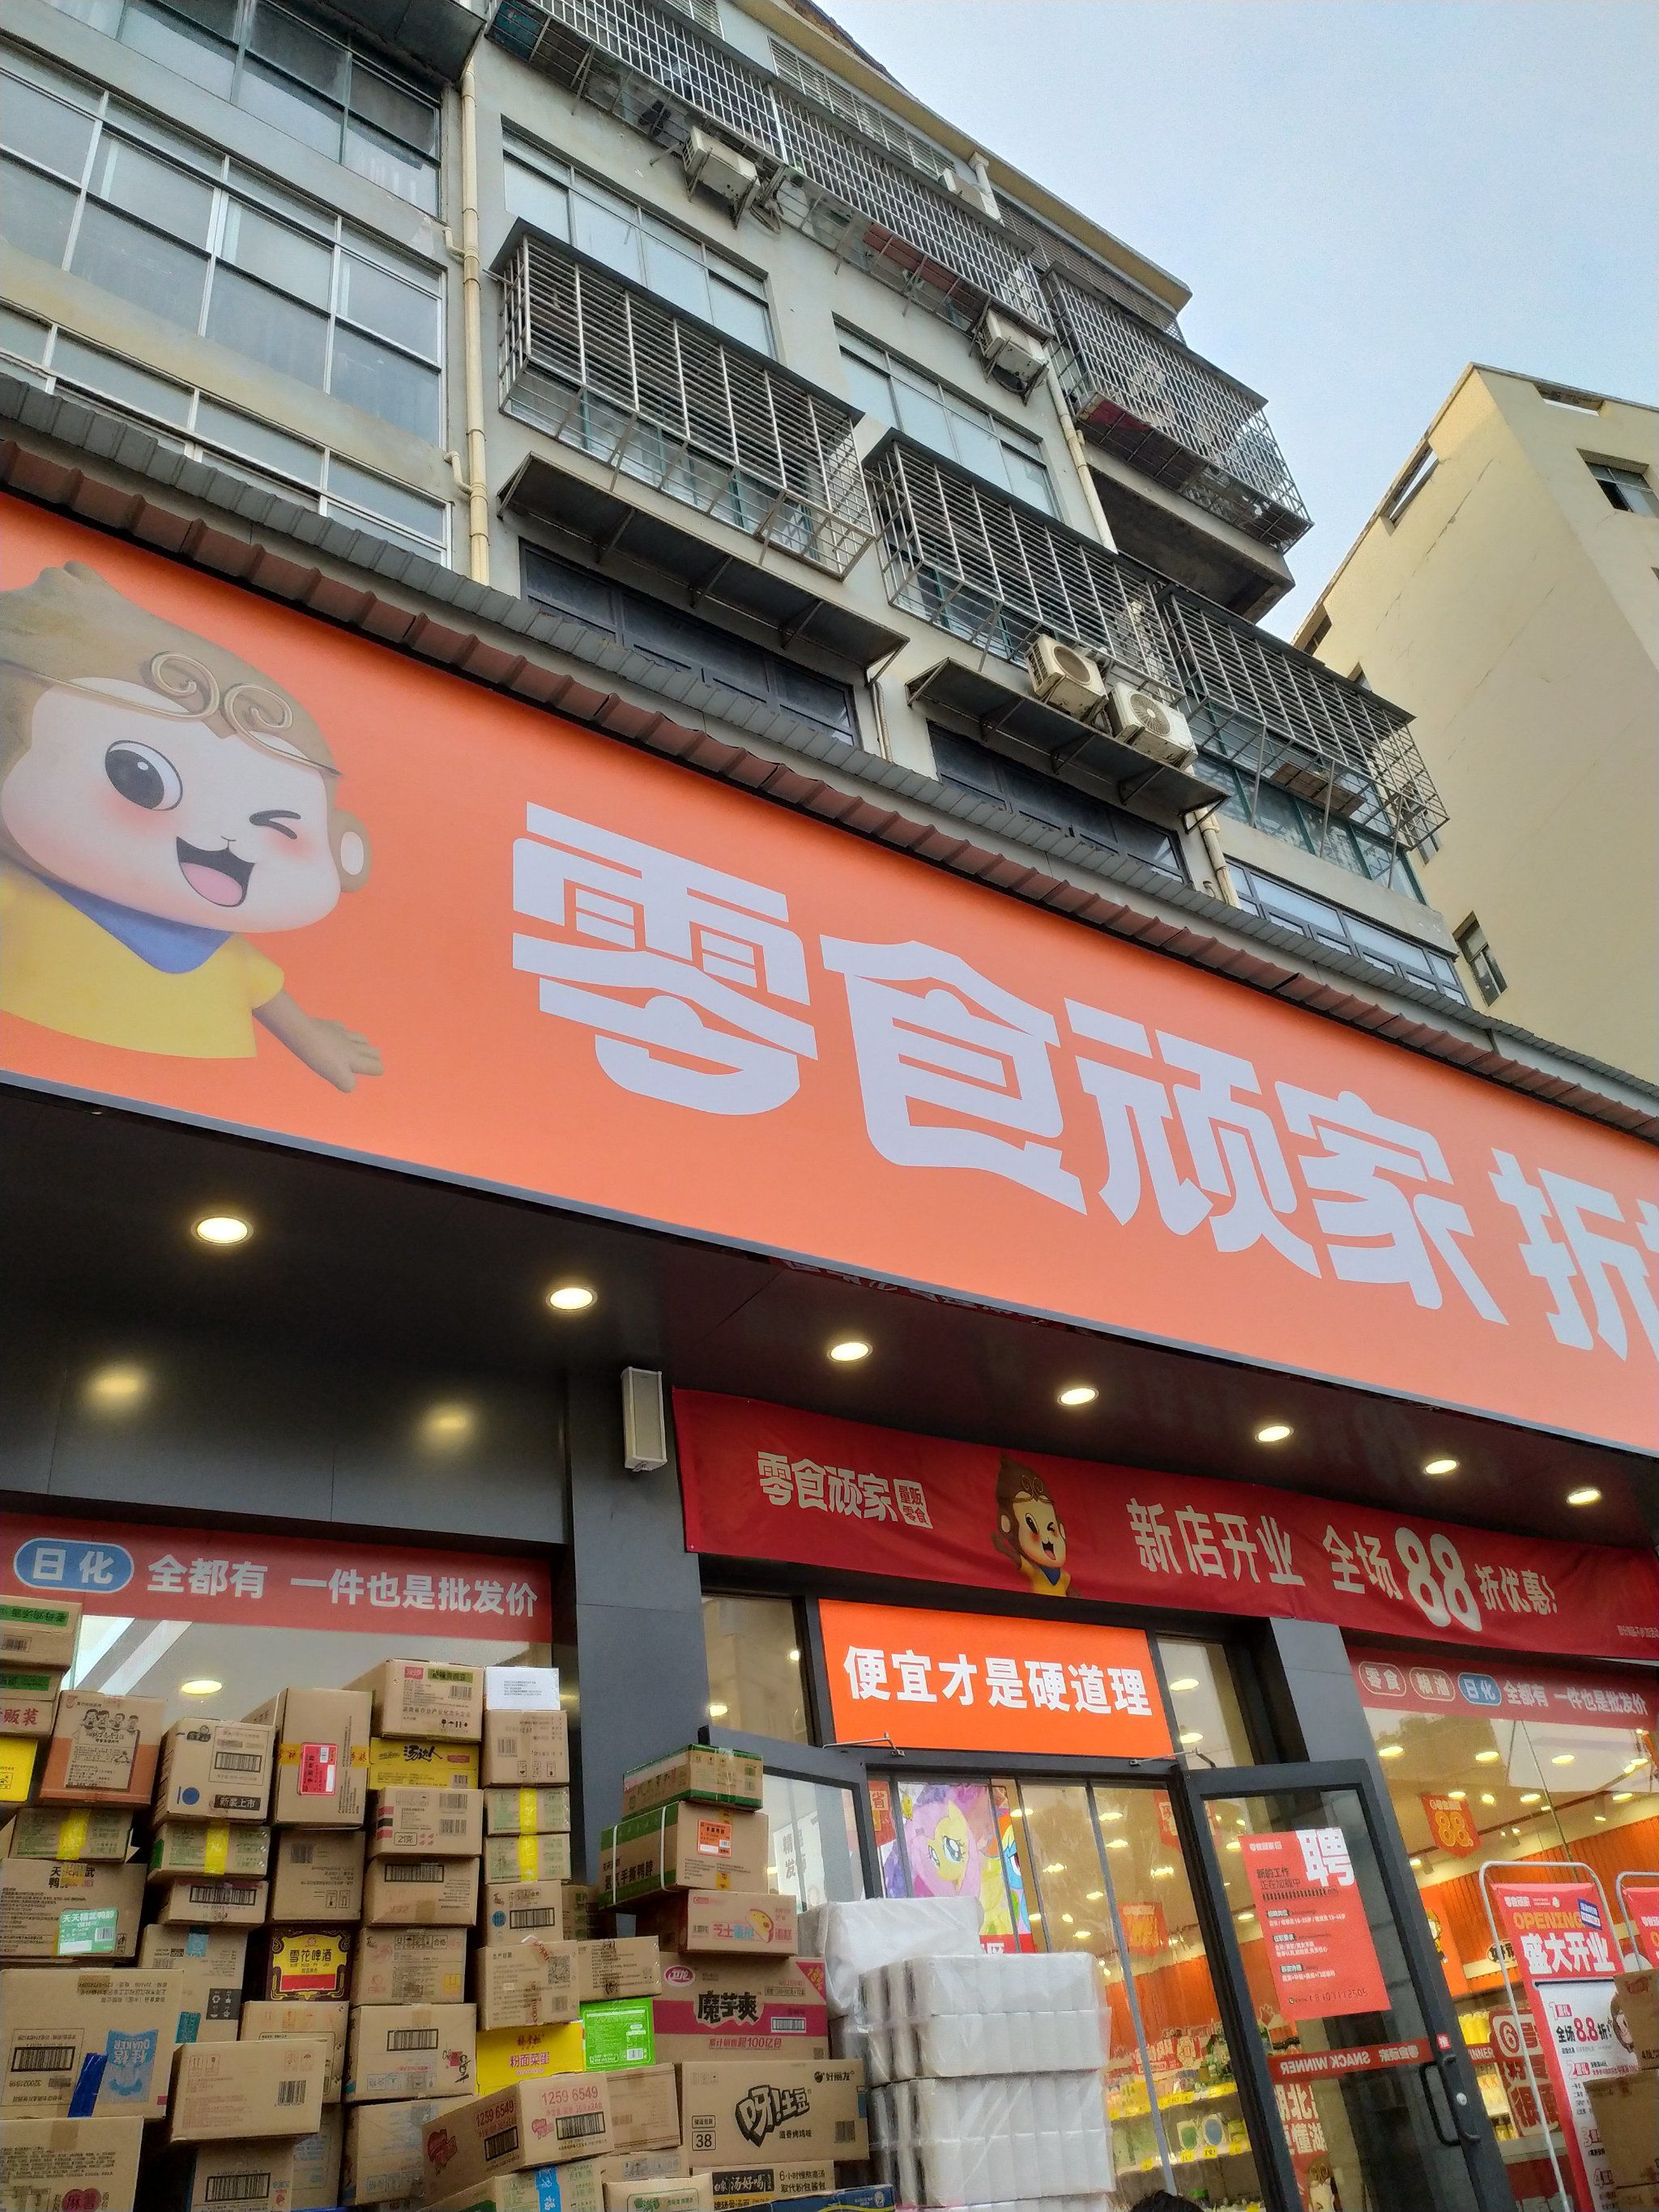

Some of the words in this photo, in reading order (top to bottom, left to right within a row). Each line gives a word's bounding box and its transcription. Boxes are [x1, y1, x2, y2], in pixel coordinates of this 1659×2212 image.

[513, 802, 1508, 1326] 零食顽家
[1488, 1147, 1659, 1362] 折
[757, 1451, 898, 1522] 零食顽家
[899, 1484, 925, 1507] 量贩
[903, 1504, 928, 1525] 零食
[1126, 1497, 1306, 1588] 新店开业
[33, 1547, 114, 1584] 日化
[147, 1554, 268, 1599] 全都有
[290, 1568, 538, 1617] 一件也是批发价
[842, 1646, 1154, 1716] 便宜才是硬道理
[1365, 1666, 1401, 1691] 零食
[1414, 1671, 1451, 1697] 粮油
[1464, 1678, 1497, 1702] 日化
[1503, 1680, 1550, 1708] 全都有
[1554, 1690, 1648, 1716] 一件也是批发价
[0, 1707, 39, 1726] 贩装
[403, 1745, 444, 1762] 汤达人
[220, 1797, 255, 1809] 新装上市
[398, 1834, 413, 1843] 21克
[1296, 1827, 1354, 1887] 聘
[50, 1866, 96, 1877] 天武
[1256, 1867, 1290, 1879] 新的工作
[289, 1948, 332, 1963] 雪花啤酒
[1520, 1932, 1616, 1975] 盛大开业
[670, 1969, 689, 1981] 卫龙
[697, 1989, 759, 2024] 魔芋爽
[1555, 2017, 1613, 2044] 全场8.8折!
[113, 2038, 151, 2050] QUAKER
[708, 2037, 783, 2049] 累计销售超100亿包
[510, 2051, 550, 2068] 粉面菜蛋
[825, 2071, 851, 2082] 好丽友
[542, 2088, 569, 2106] 1259
[572, 2086, 599, 2103] 6549
[475, 2106, 495, 2128] 1259
[495, 2099, 514, 2120] 6549
[696, 2133, 712, 2148] 38
[778, 2129, 812, 2139] 滋香烤鸡味
[731, 2174, 764, 2191] 汤好喝
[778, 2169, 825, 2182] 6小时慢熬高汤
[780, 2182, 825, 2193] 取代粉包酱包
